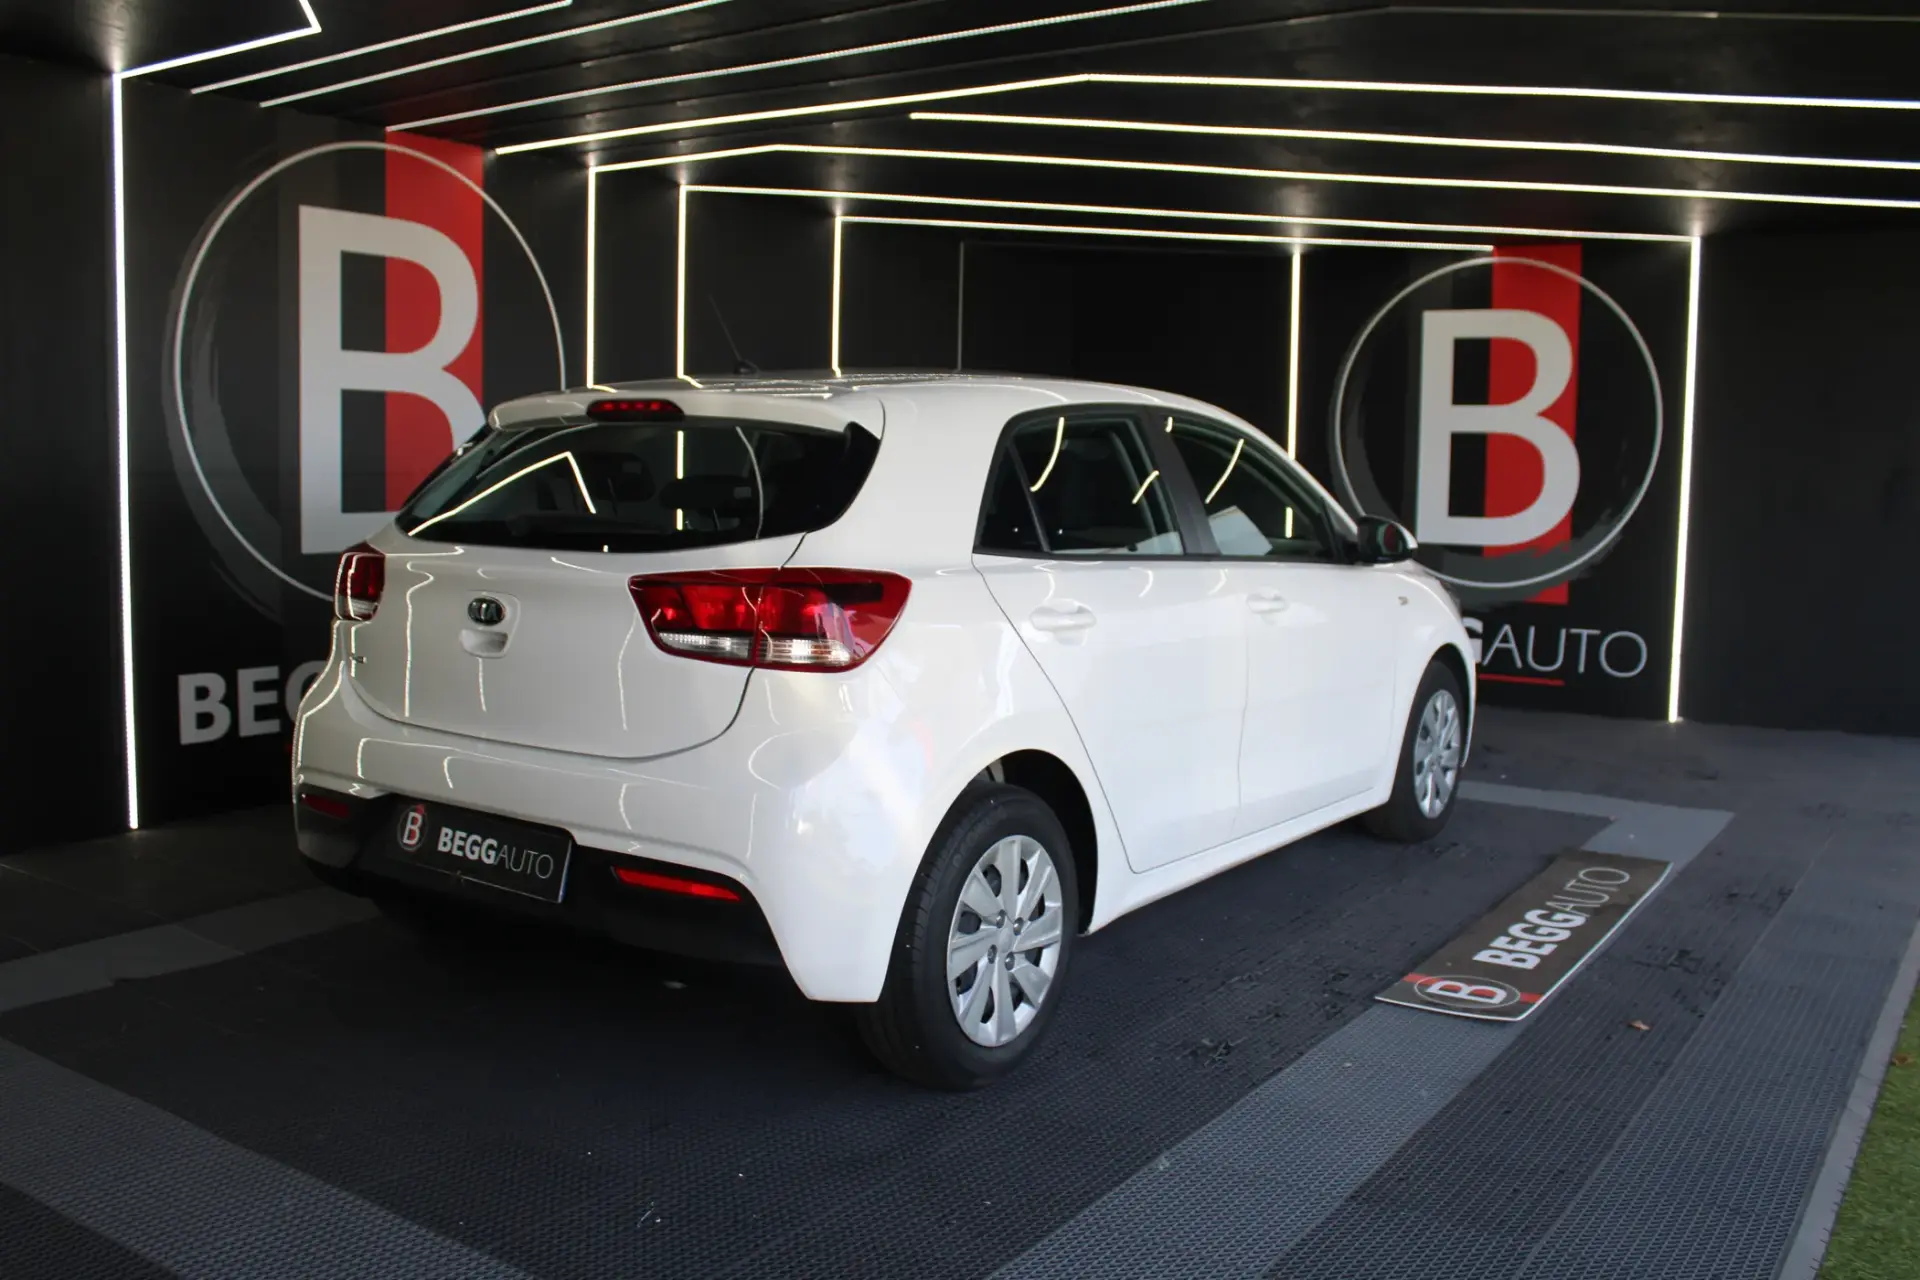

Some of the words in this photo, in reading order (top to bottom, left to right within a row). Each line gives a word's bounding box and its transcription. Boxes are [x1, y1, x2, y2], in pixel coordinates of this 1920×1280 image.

[300, 204, 486, 555] B
[1416, 308, 1581, 547] B
[402, 811, 423, 845] B
[437, 826, 554, 880] BEGGAUTO
[1424, 980, 1508, 1005] B
[1472, 866, 1631, 970] BEGGAUTO
